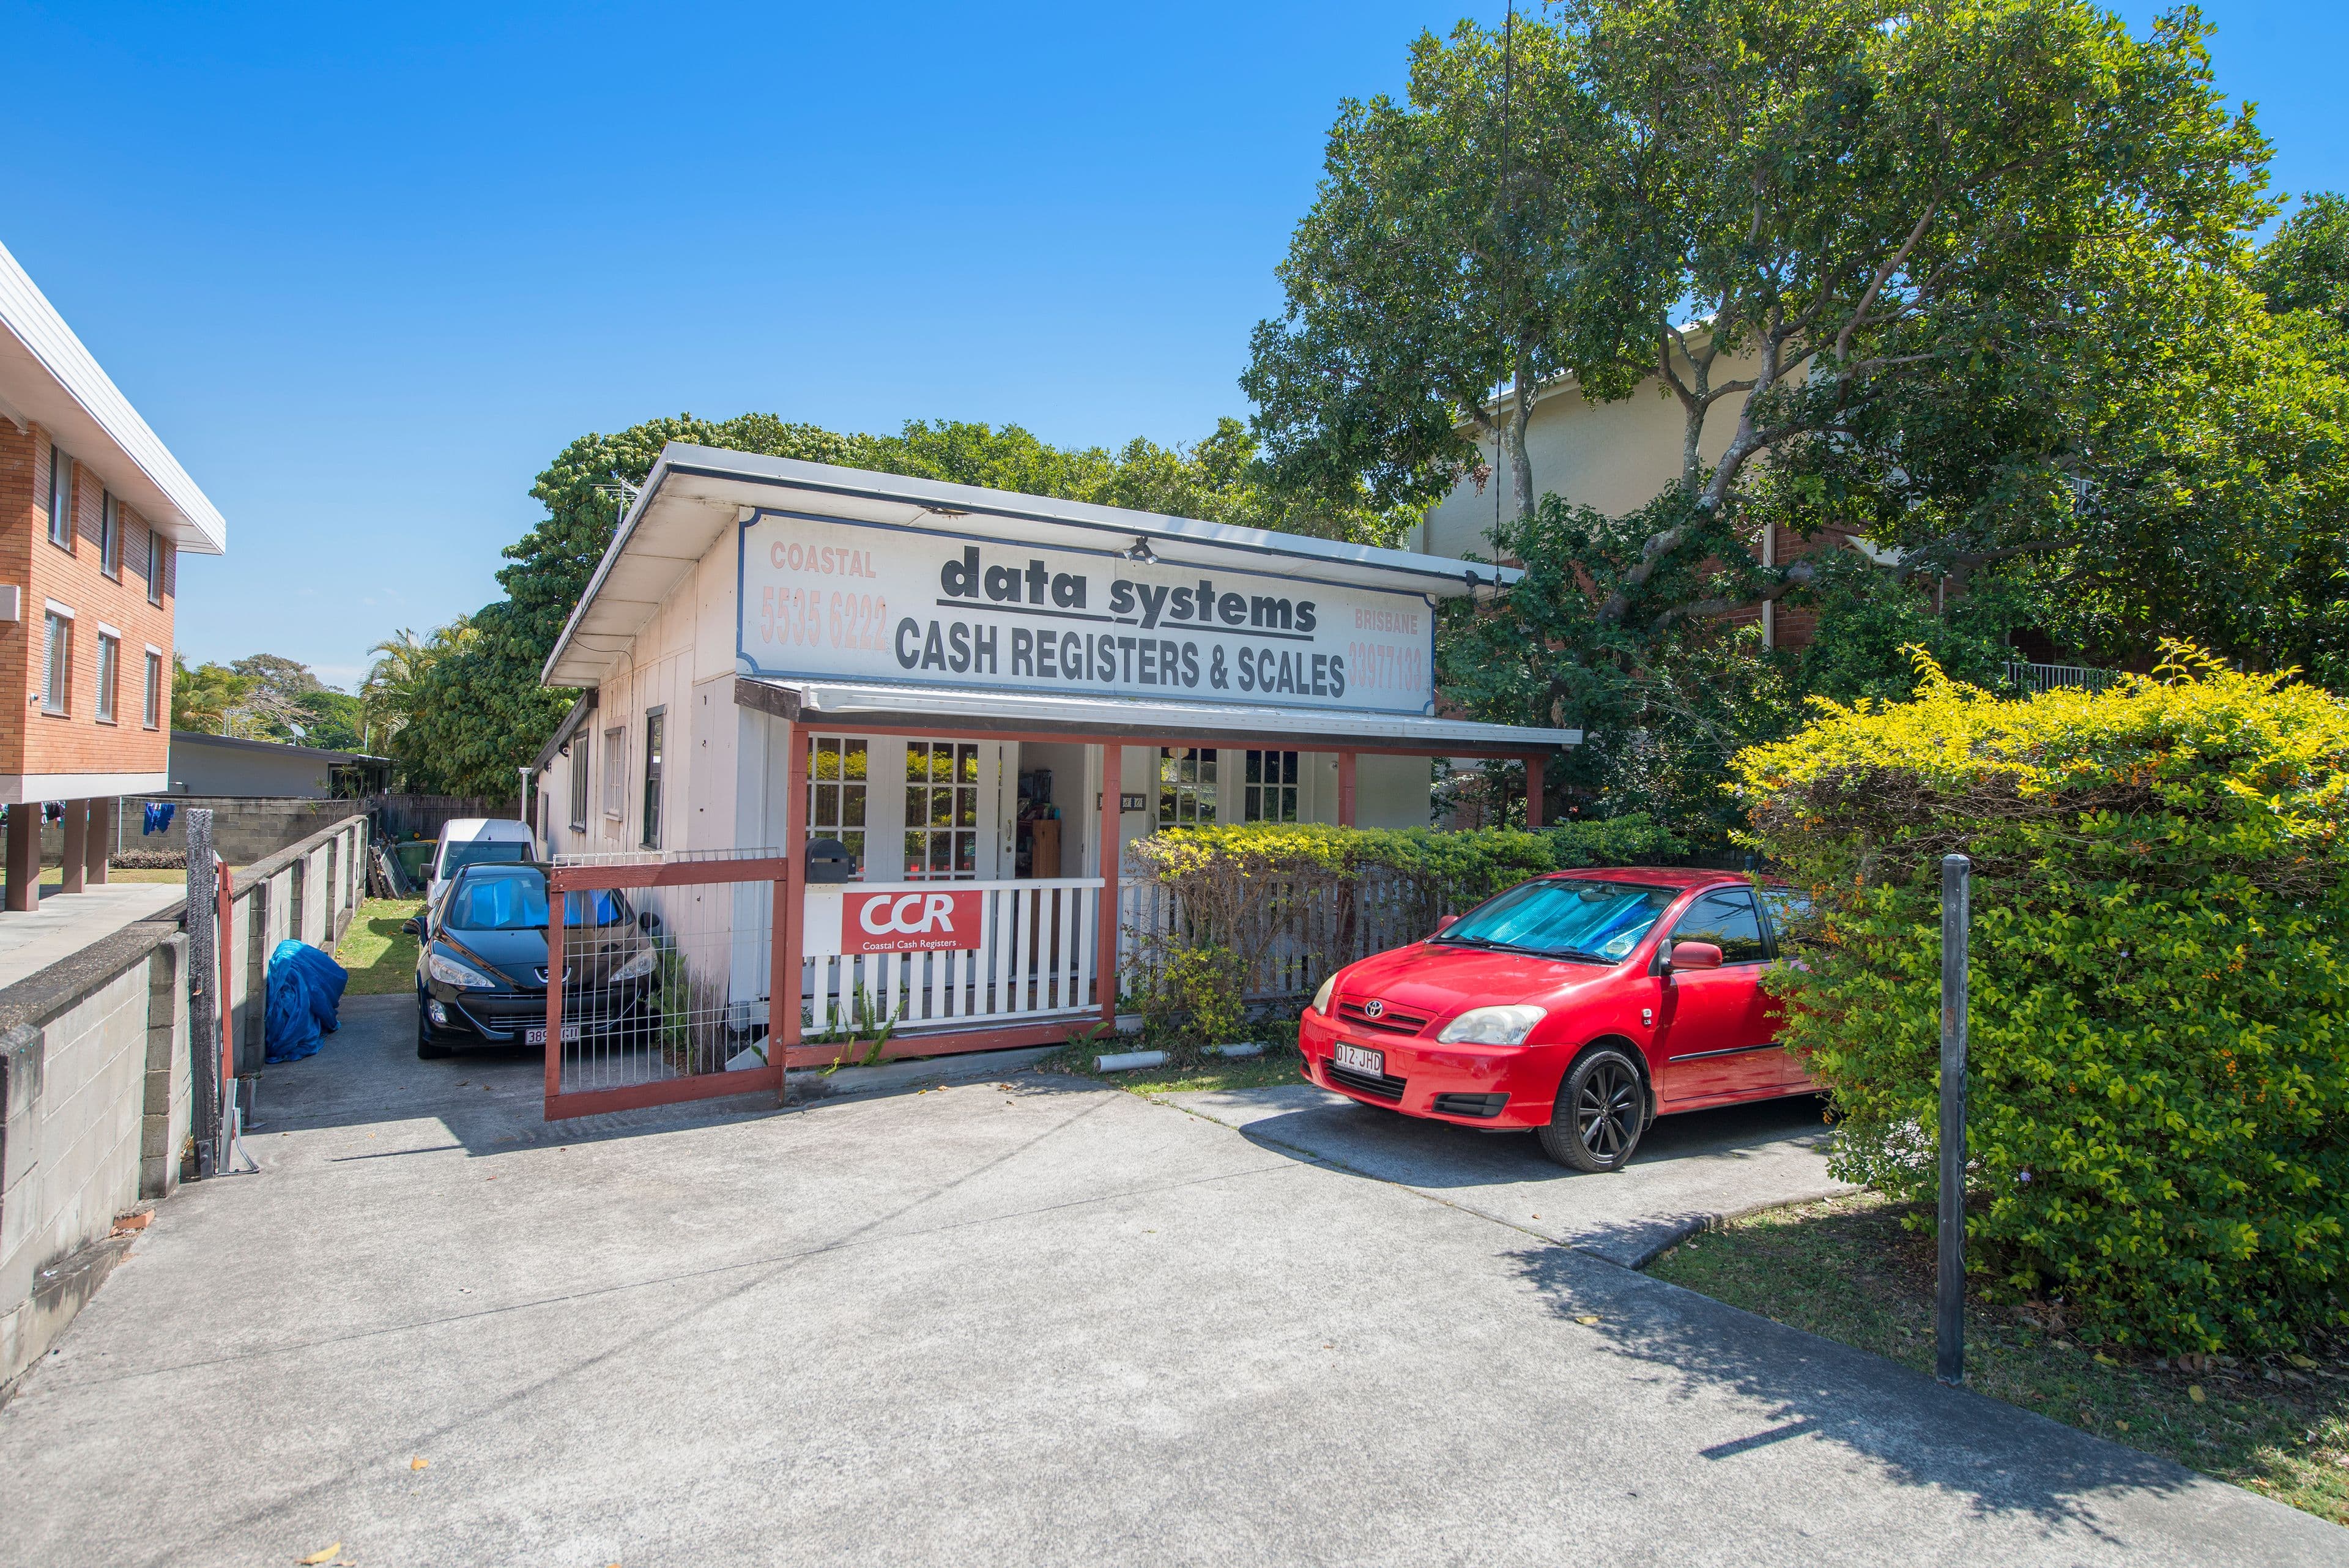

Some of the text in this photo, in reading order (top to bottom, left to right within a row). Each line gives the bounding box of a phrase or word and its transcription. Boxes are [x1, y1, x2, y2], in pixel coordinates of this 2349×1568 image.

[770, 540, 877, 579] COASTAL
[941, 545, 1316, 633] data systems
[760, 585, 886, 651] 5535 6222
[1355, 608, 1419, 635] BRISBANE
[895, 617, 1345, 699] CASH REGISTERS & SCALES
[859, 894, 954, 935] CCR
[863, 939, 957, 950] Coastal Cash Registers
